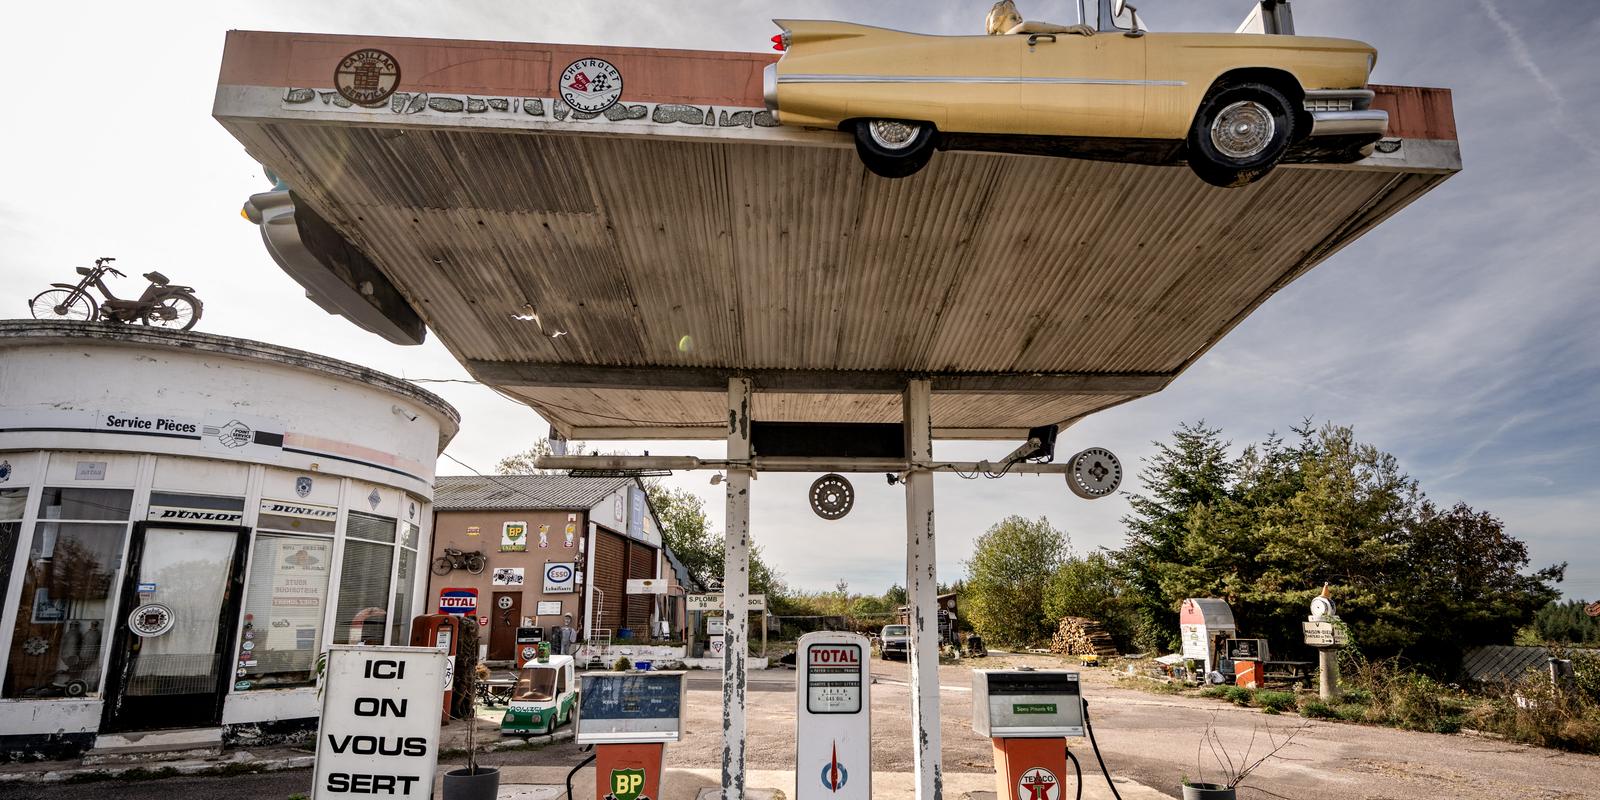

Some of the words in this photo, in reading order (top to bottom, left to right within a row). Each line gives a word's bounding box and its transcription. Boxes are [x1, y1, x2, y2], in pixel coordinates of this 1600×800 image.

[343, 52, 394, 72] CADILLAC
[563, 60, 620, 81] CHEVROLET
[343, 85, 387, 100] SERVICE
[564, 92, 618, 111] Corvette
[106, 415, 152, 430] Service
[156, 418, 197, 433] Pièces
[161, 510, 242, 521] DUNLOP
[271, 504, 336, 517] DUNLOP
[508, 527, 522, 537] BP
[441, 598, 475, 607] TOTAL
[811, 649, 858, 663] TOTAL
[363, 659, 406, 680] ICI
[354, 697, 408, 718] ON
[509, 705, 542, 713] POLIZEI
[328, 734, 427, 757] VOUS
[327, 772, 420, 796] SERT
[616, 774, 643, 795] BP
[1024, 775, 1054, 783] TEXACO
